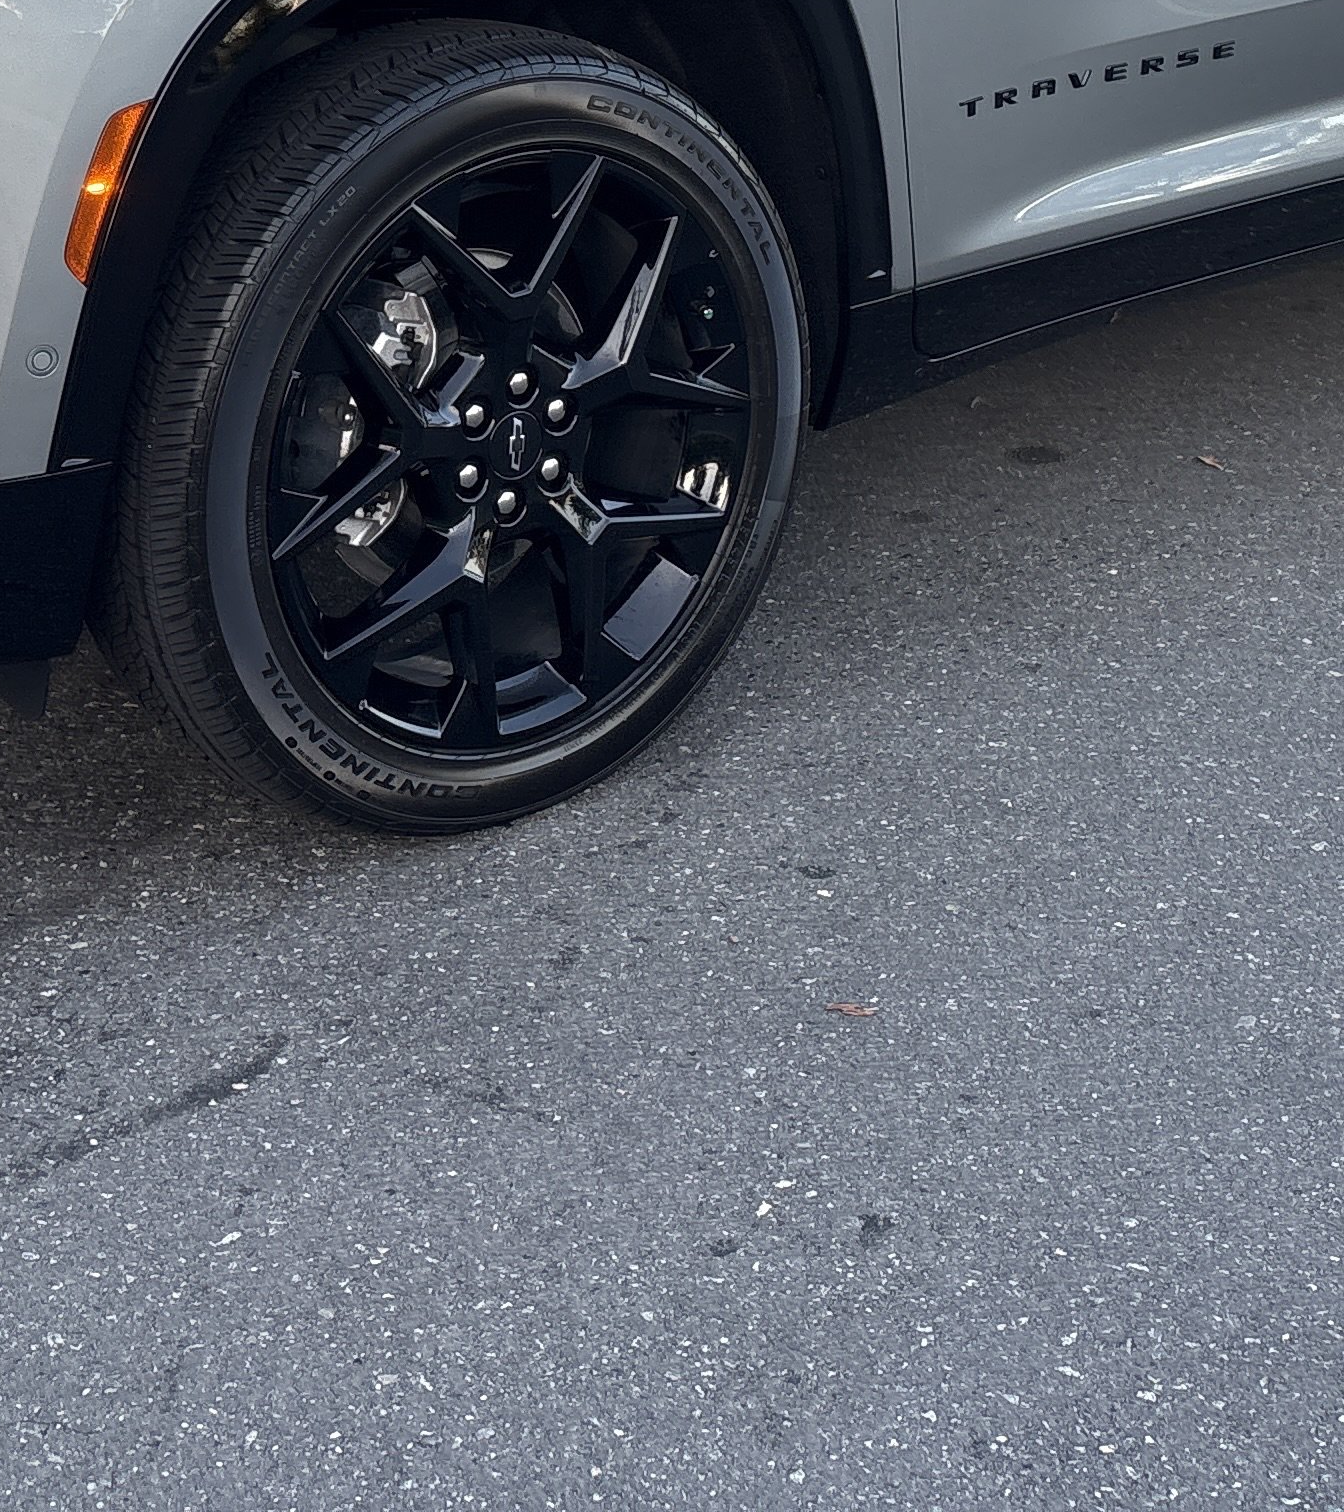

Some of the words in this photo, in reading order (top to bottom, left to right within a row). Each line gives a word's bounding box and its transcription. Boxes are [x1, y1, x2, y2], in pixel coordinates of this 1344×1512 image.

[958, 40, 1236, 118] TRAVERSE
[587, 94, 771, 265] CONTINENTAL
[261, 651, 483, 799] CONTINENTAL
